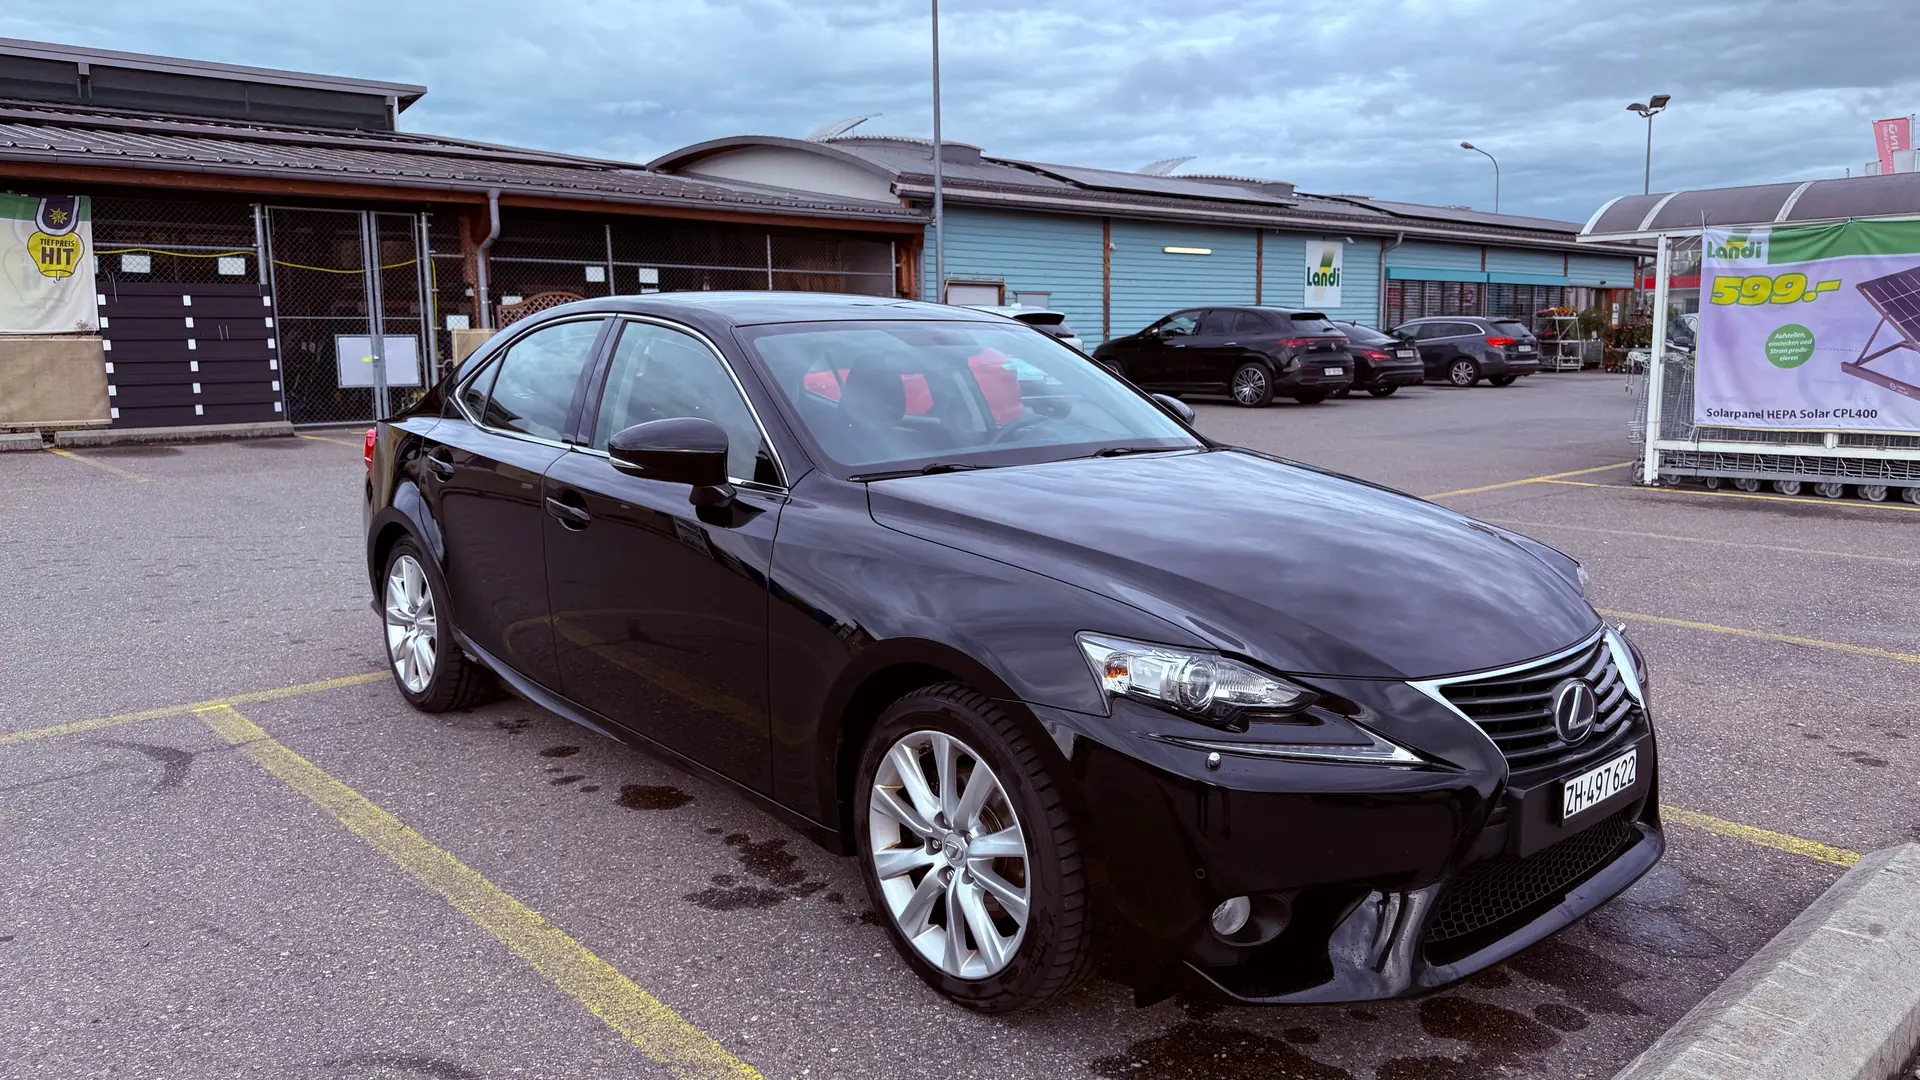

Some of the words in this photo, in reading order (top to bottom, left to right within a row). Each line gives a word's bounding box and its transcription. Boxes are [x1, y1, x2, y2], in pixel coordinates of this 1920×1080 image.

[40, 239, 75, 247] TIEFPREIS
[1707, 241, 1762, 259] Landi
[41, 247, 74, 265] HIT
[1307, 266, 1340, 287] Landi
[1710, 273, 1842, 306] 599.-
[1706, 408, 1764, 420] Solarpanel
[1766, 410, 1797, 419] HEPA
[1799, 409, 1830, 419] Solar
[1833, 408, 1878, 418] CPL400
